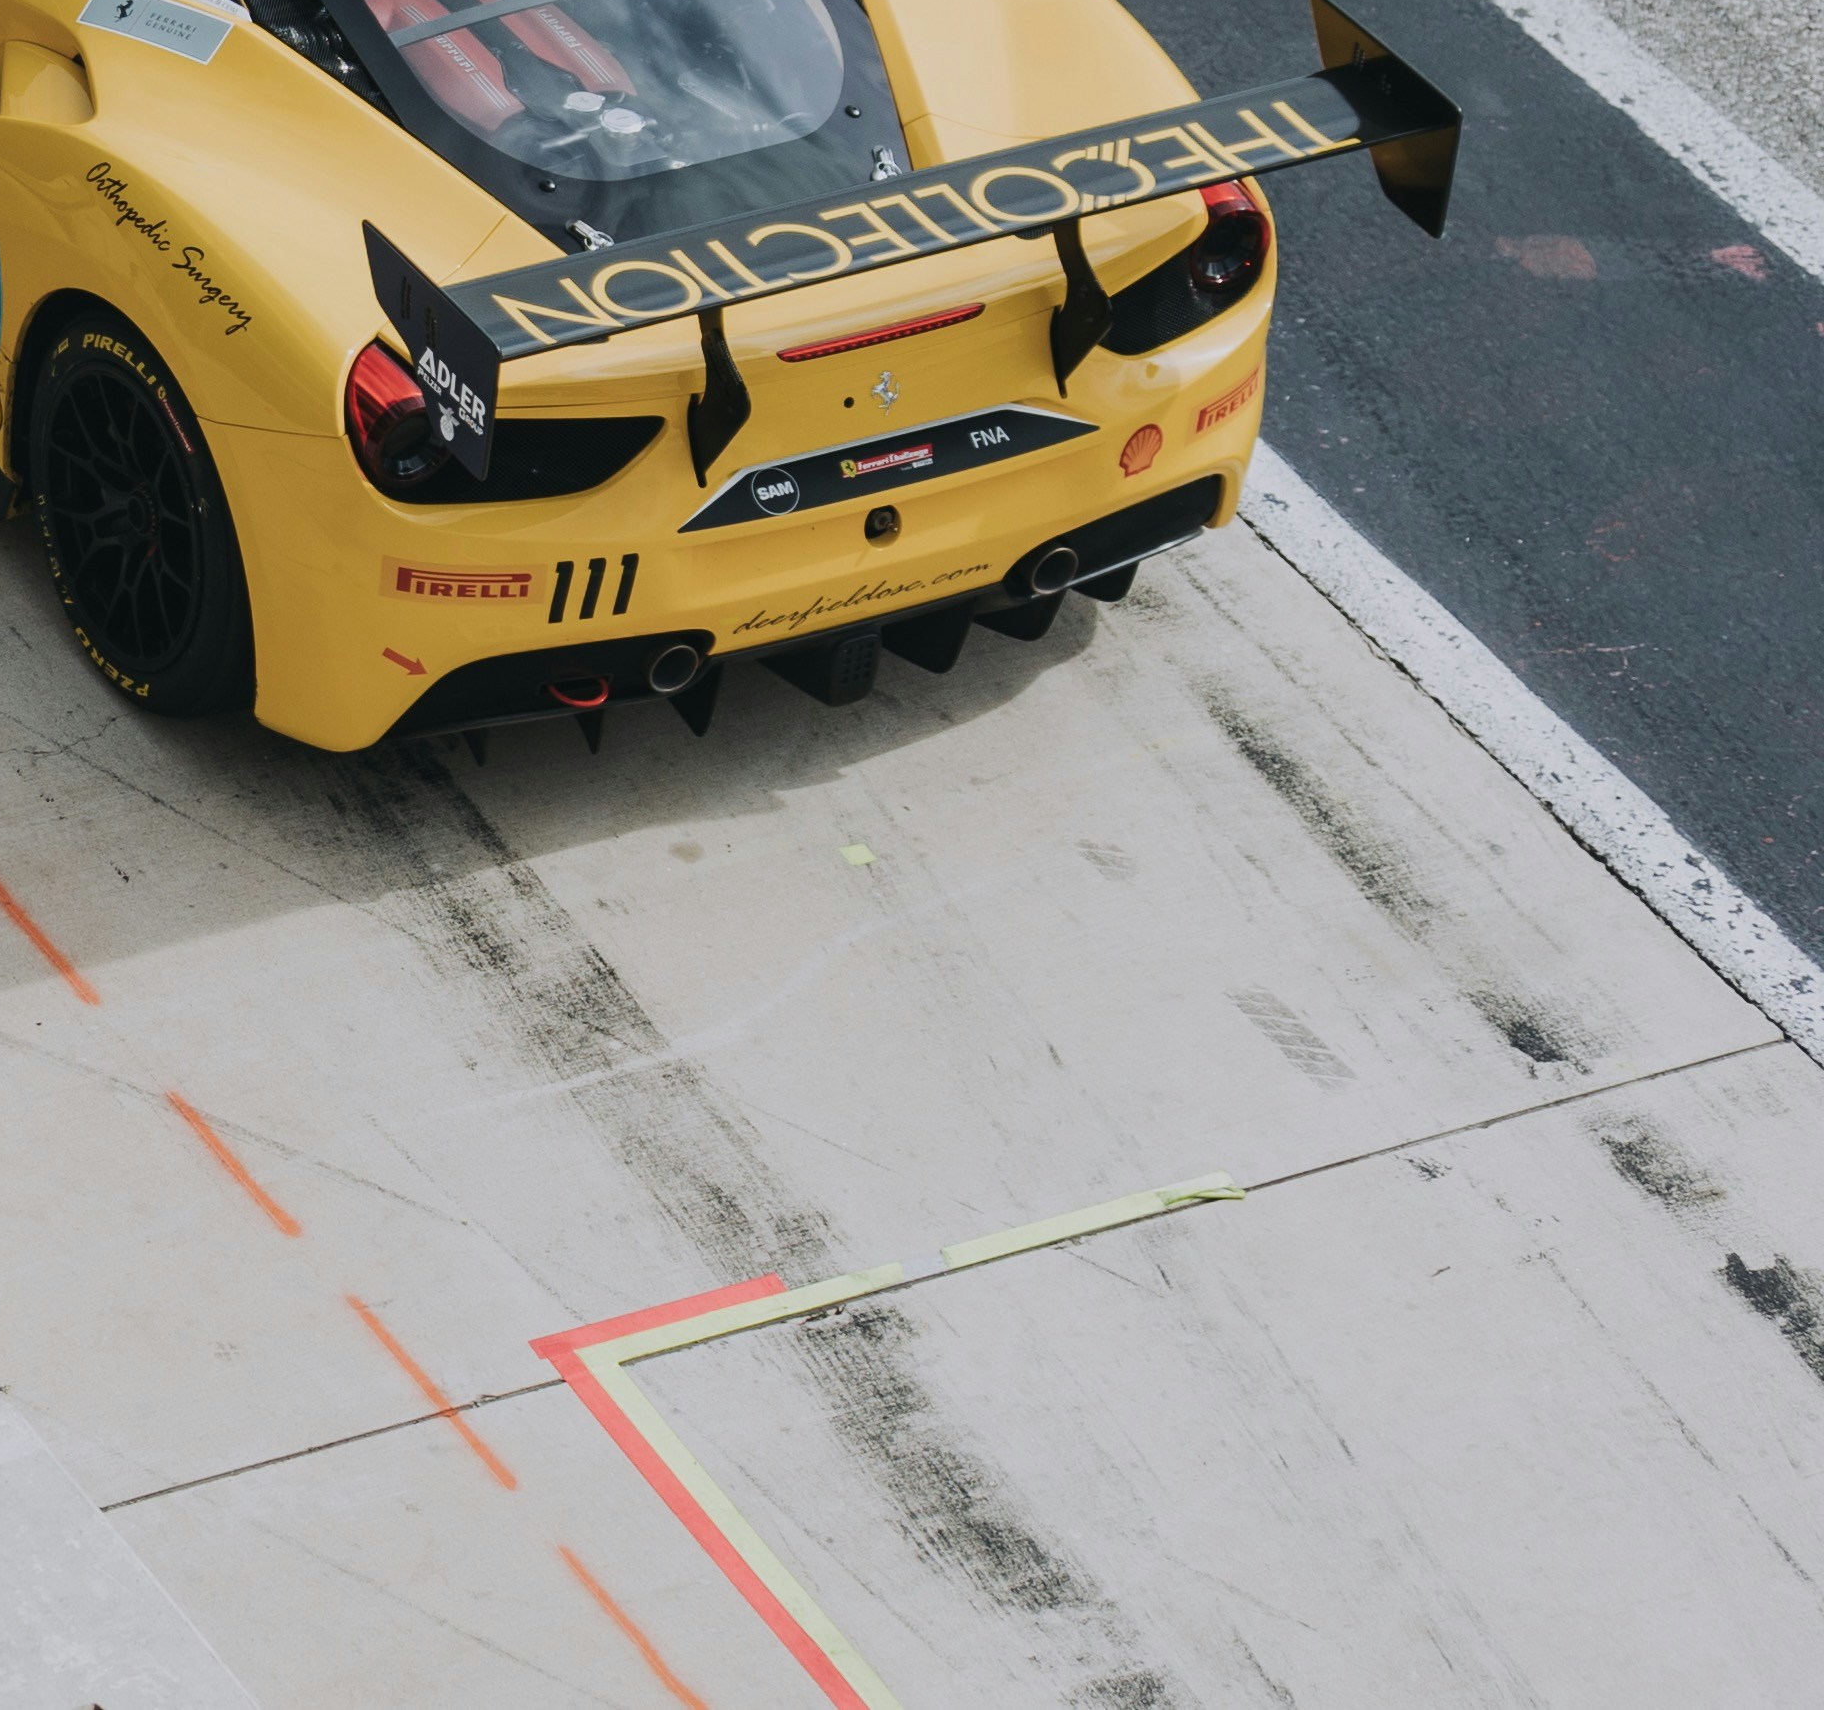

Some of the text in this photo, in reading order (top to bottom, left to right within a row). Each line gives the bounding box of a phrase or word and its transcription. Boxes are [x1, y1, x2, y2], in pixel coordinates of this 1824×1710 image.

[86, 161, 252, 336] Orthopedic Surgery
[83, 332, 157, 386] PIRELLI
[418, 346, 487, 428] ADLER
[1195, 365, 1261, 434] PIRELLI
[970, 425, 1011, 449] FNA
[756, 480, 795, 502] SAM
[396, 566, 533, 599] PIRELLI
[547, 552, 640, 625] 111
[731, 563, 993, 636] deerfieldosc.com
